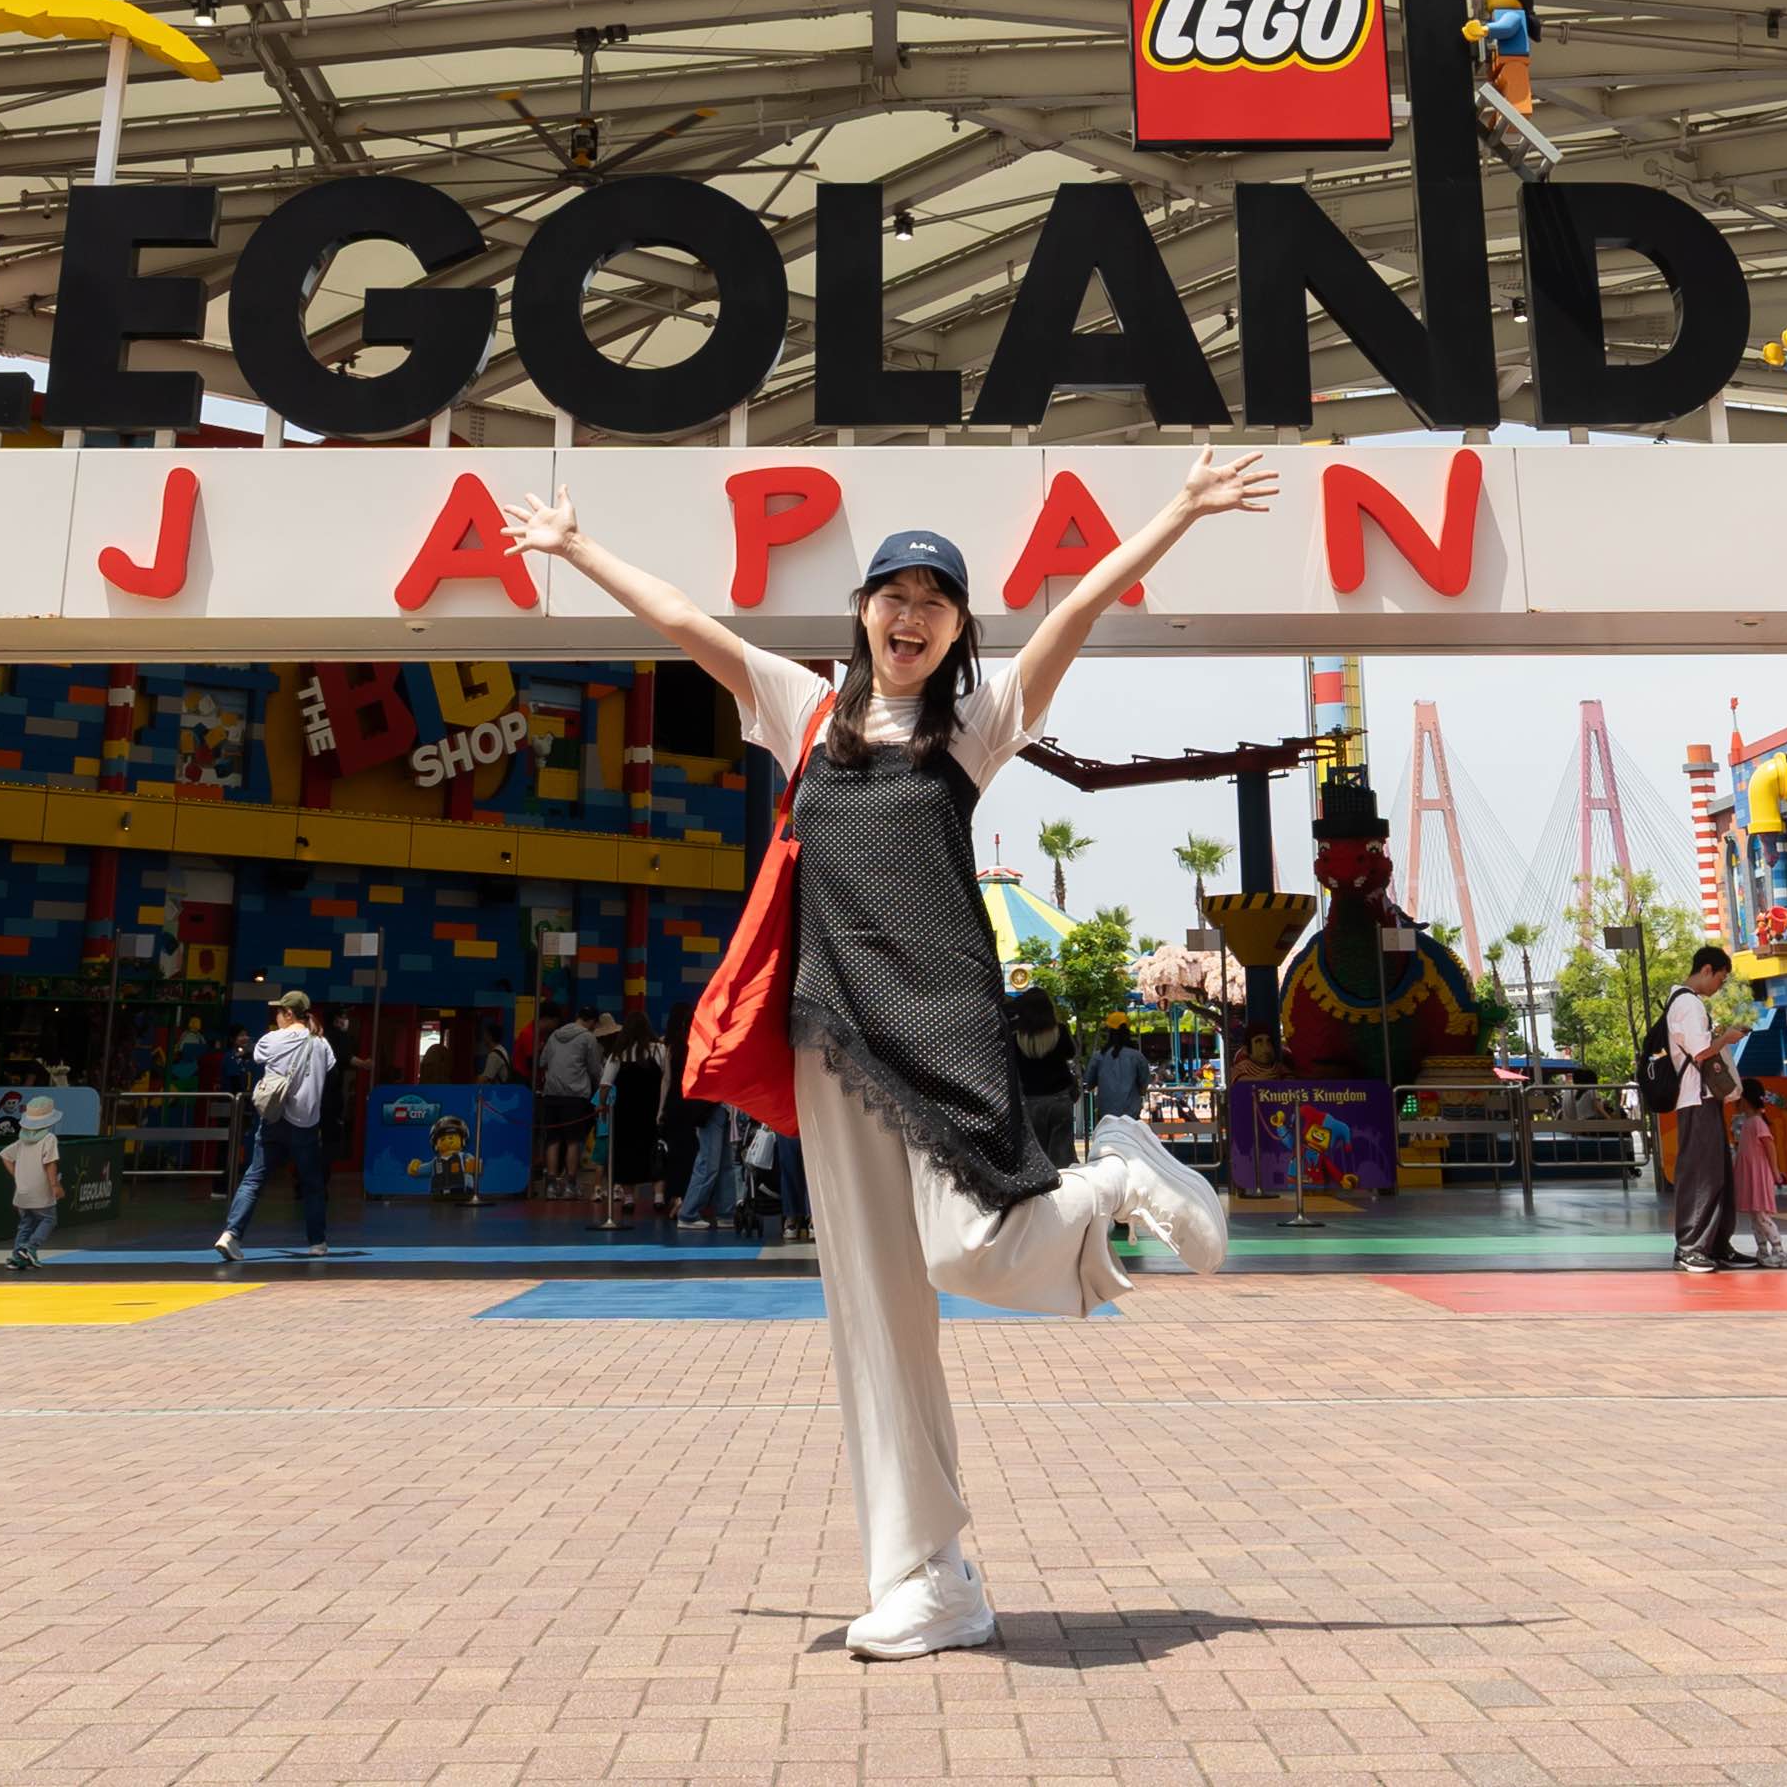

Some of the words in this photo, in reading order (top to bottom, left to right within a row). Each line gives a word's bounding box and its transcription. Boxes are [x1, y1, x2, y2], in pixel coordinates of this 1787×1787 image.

[98, 449, 1483, 609] JAPAN
[298, 675, 336, 756] THE
[411, 711, 528, 788] SHOP
[1313, 1088, 1367, 1105] Kingdom
